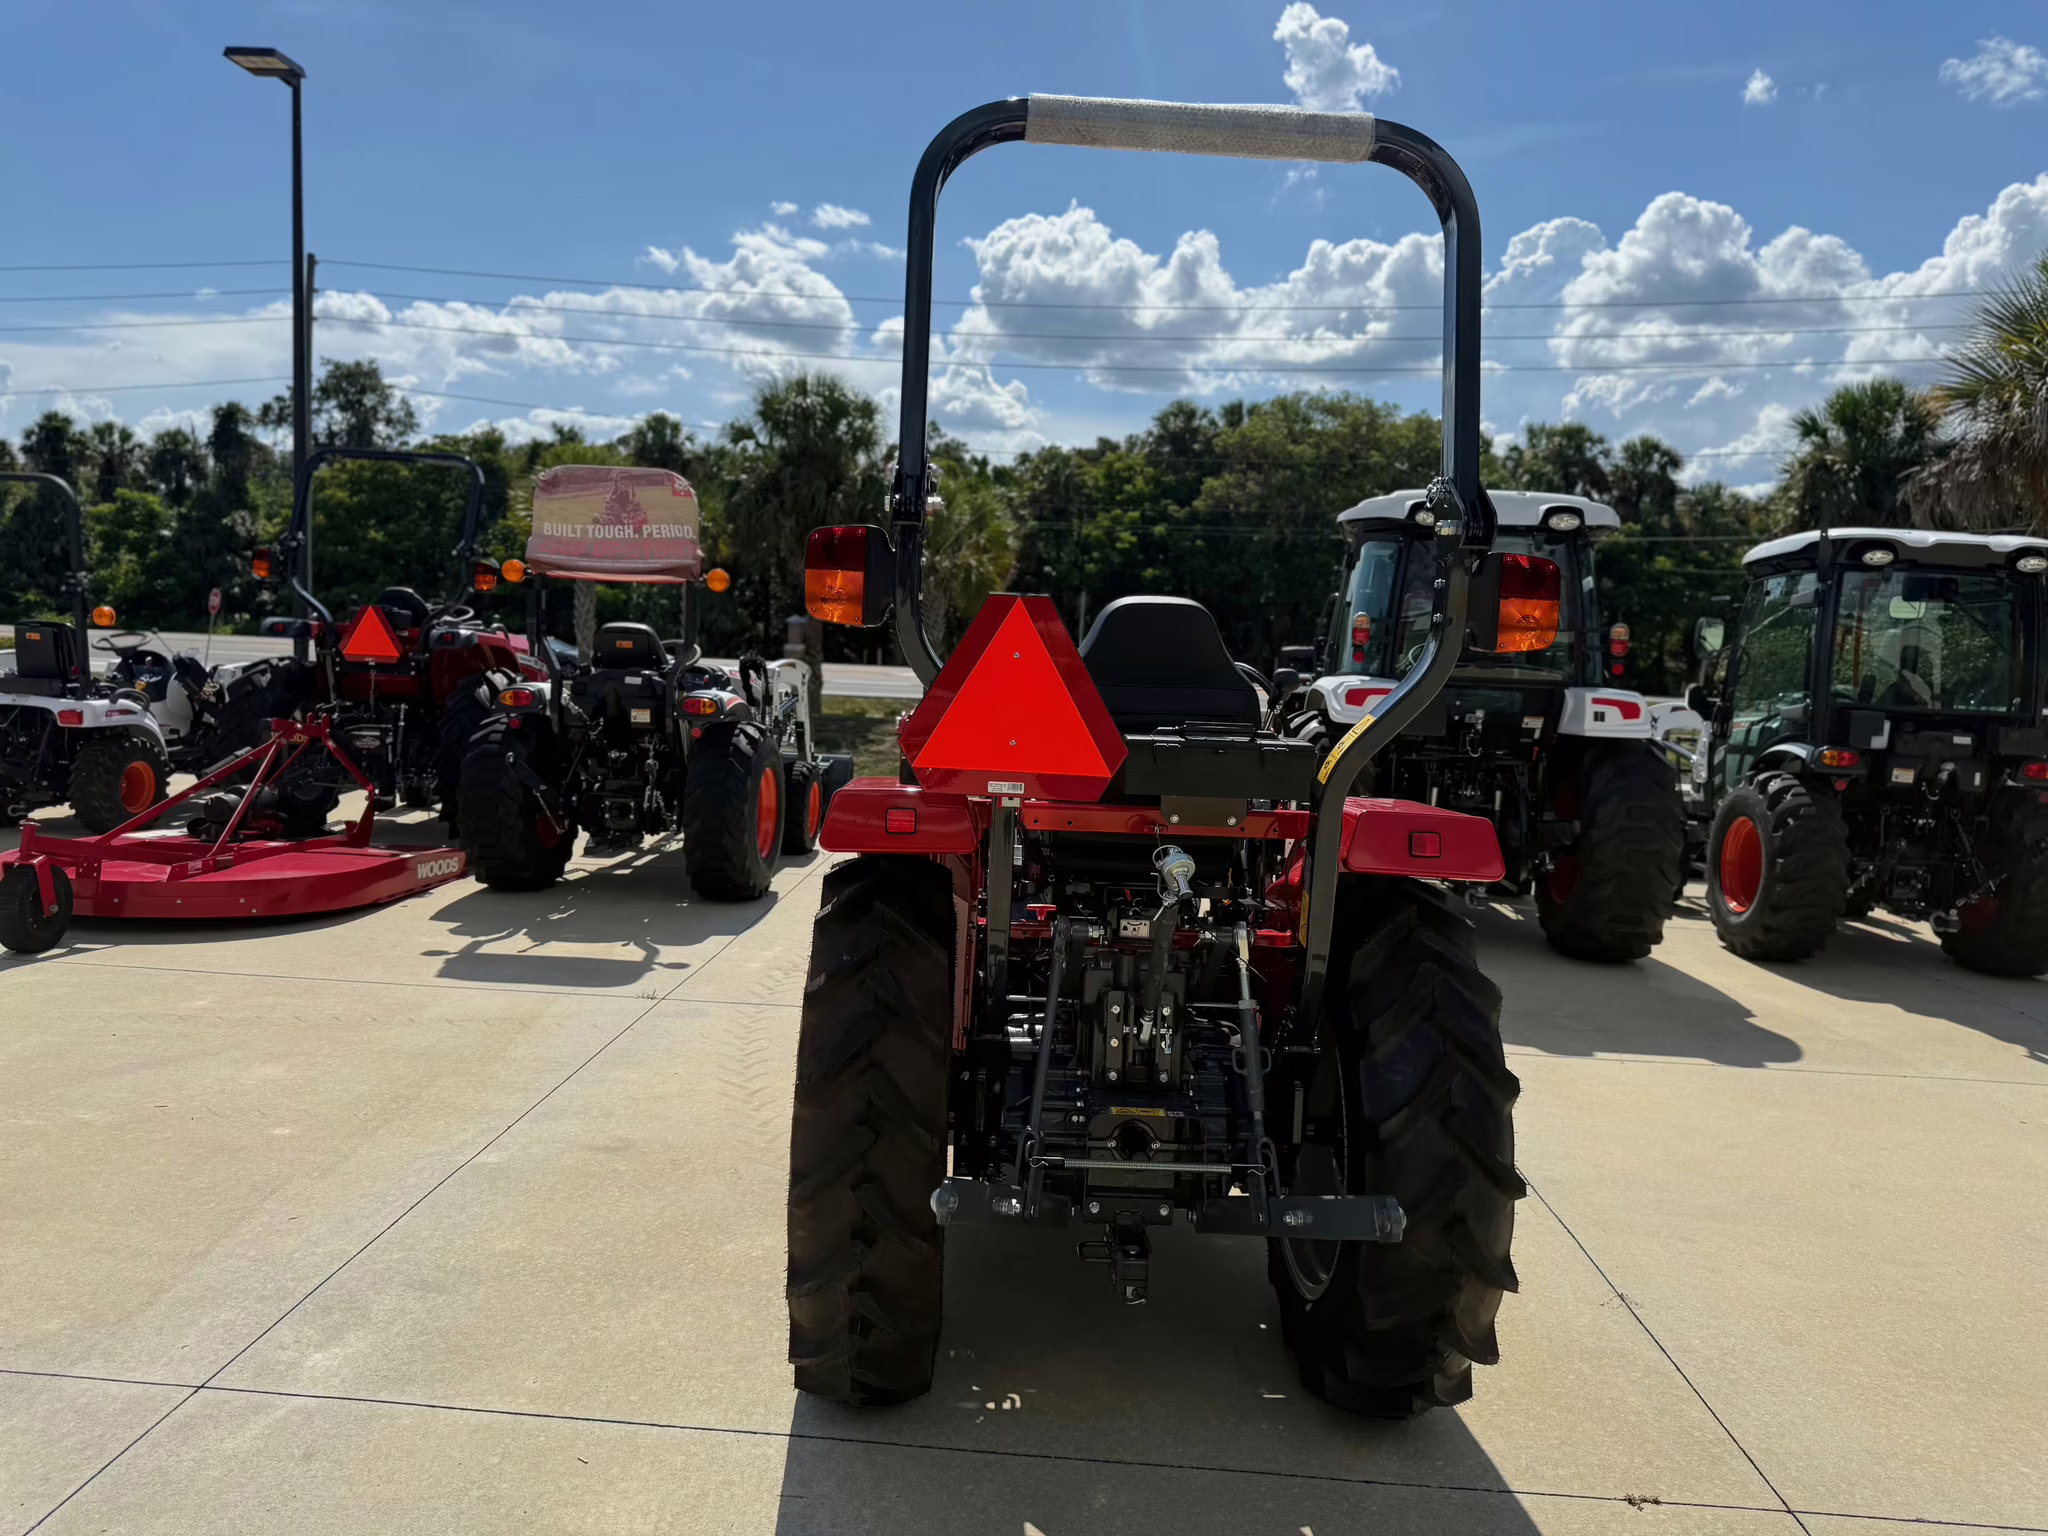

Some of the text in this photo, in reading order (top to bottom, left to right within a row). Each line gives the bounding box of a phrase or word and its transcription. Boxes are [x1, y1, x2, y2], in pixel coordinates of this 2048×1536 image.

[543, 521, 697, 539] BUILT TOUGH. PERIOD.
[417, 856, 459, 879] WOODS
